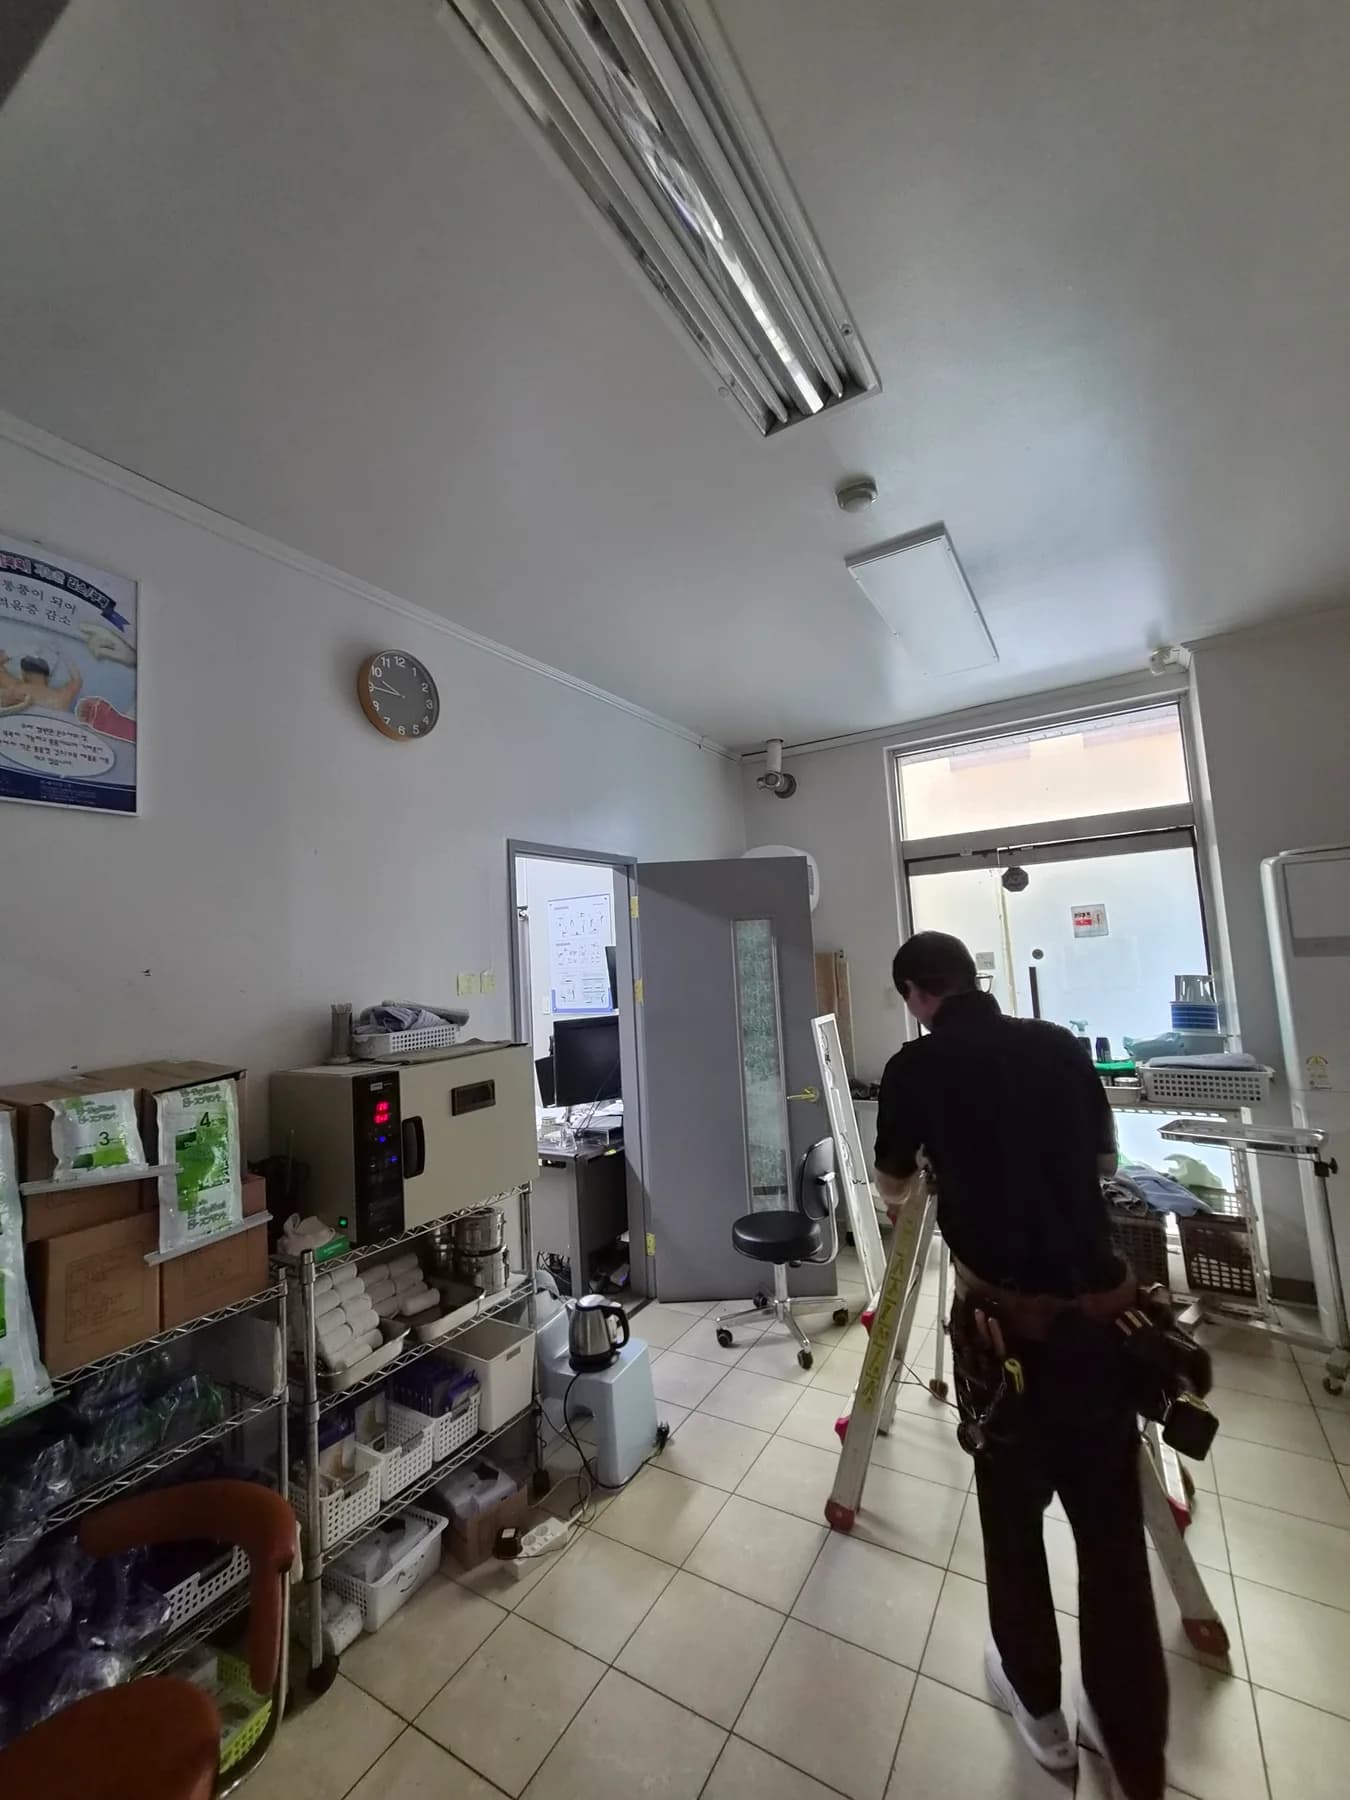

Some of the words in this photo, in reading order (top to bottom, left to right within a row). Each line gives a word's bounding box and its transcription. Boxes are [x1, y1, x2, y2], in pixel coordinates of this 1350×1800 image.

[381, 656, 391, 669] 11
[393, 655, 406, 668] 12
[371, 665, 382, 678] 10
[421, 682, 429, 693] 2
[425, 699, 433, 710] 3
[383, 716, 391, 725] 7
[422, 715, 429, 725] 4
[398, 725, 406, 736] 6
[412, 724, 420, 735] 5
[200, 1111, 211, 1127] 4
[98, 1131, 110, 1146] 3
